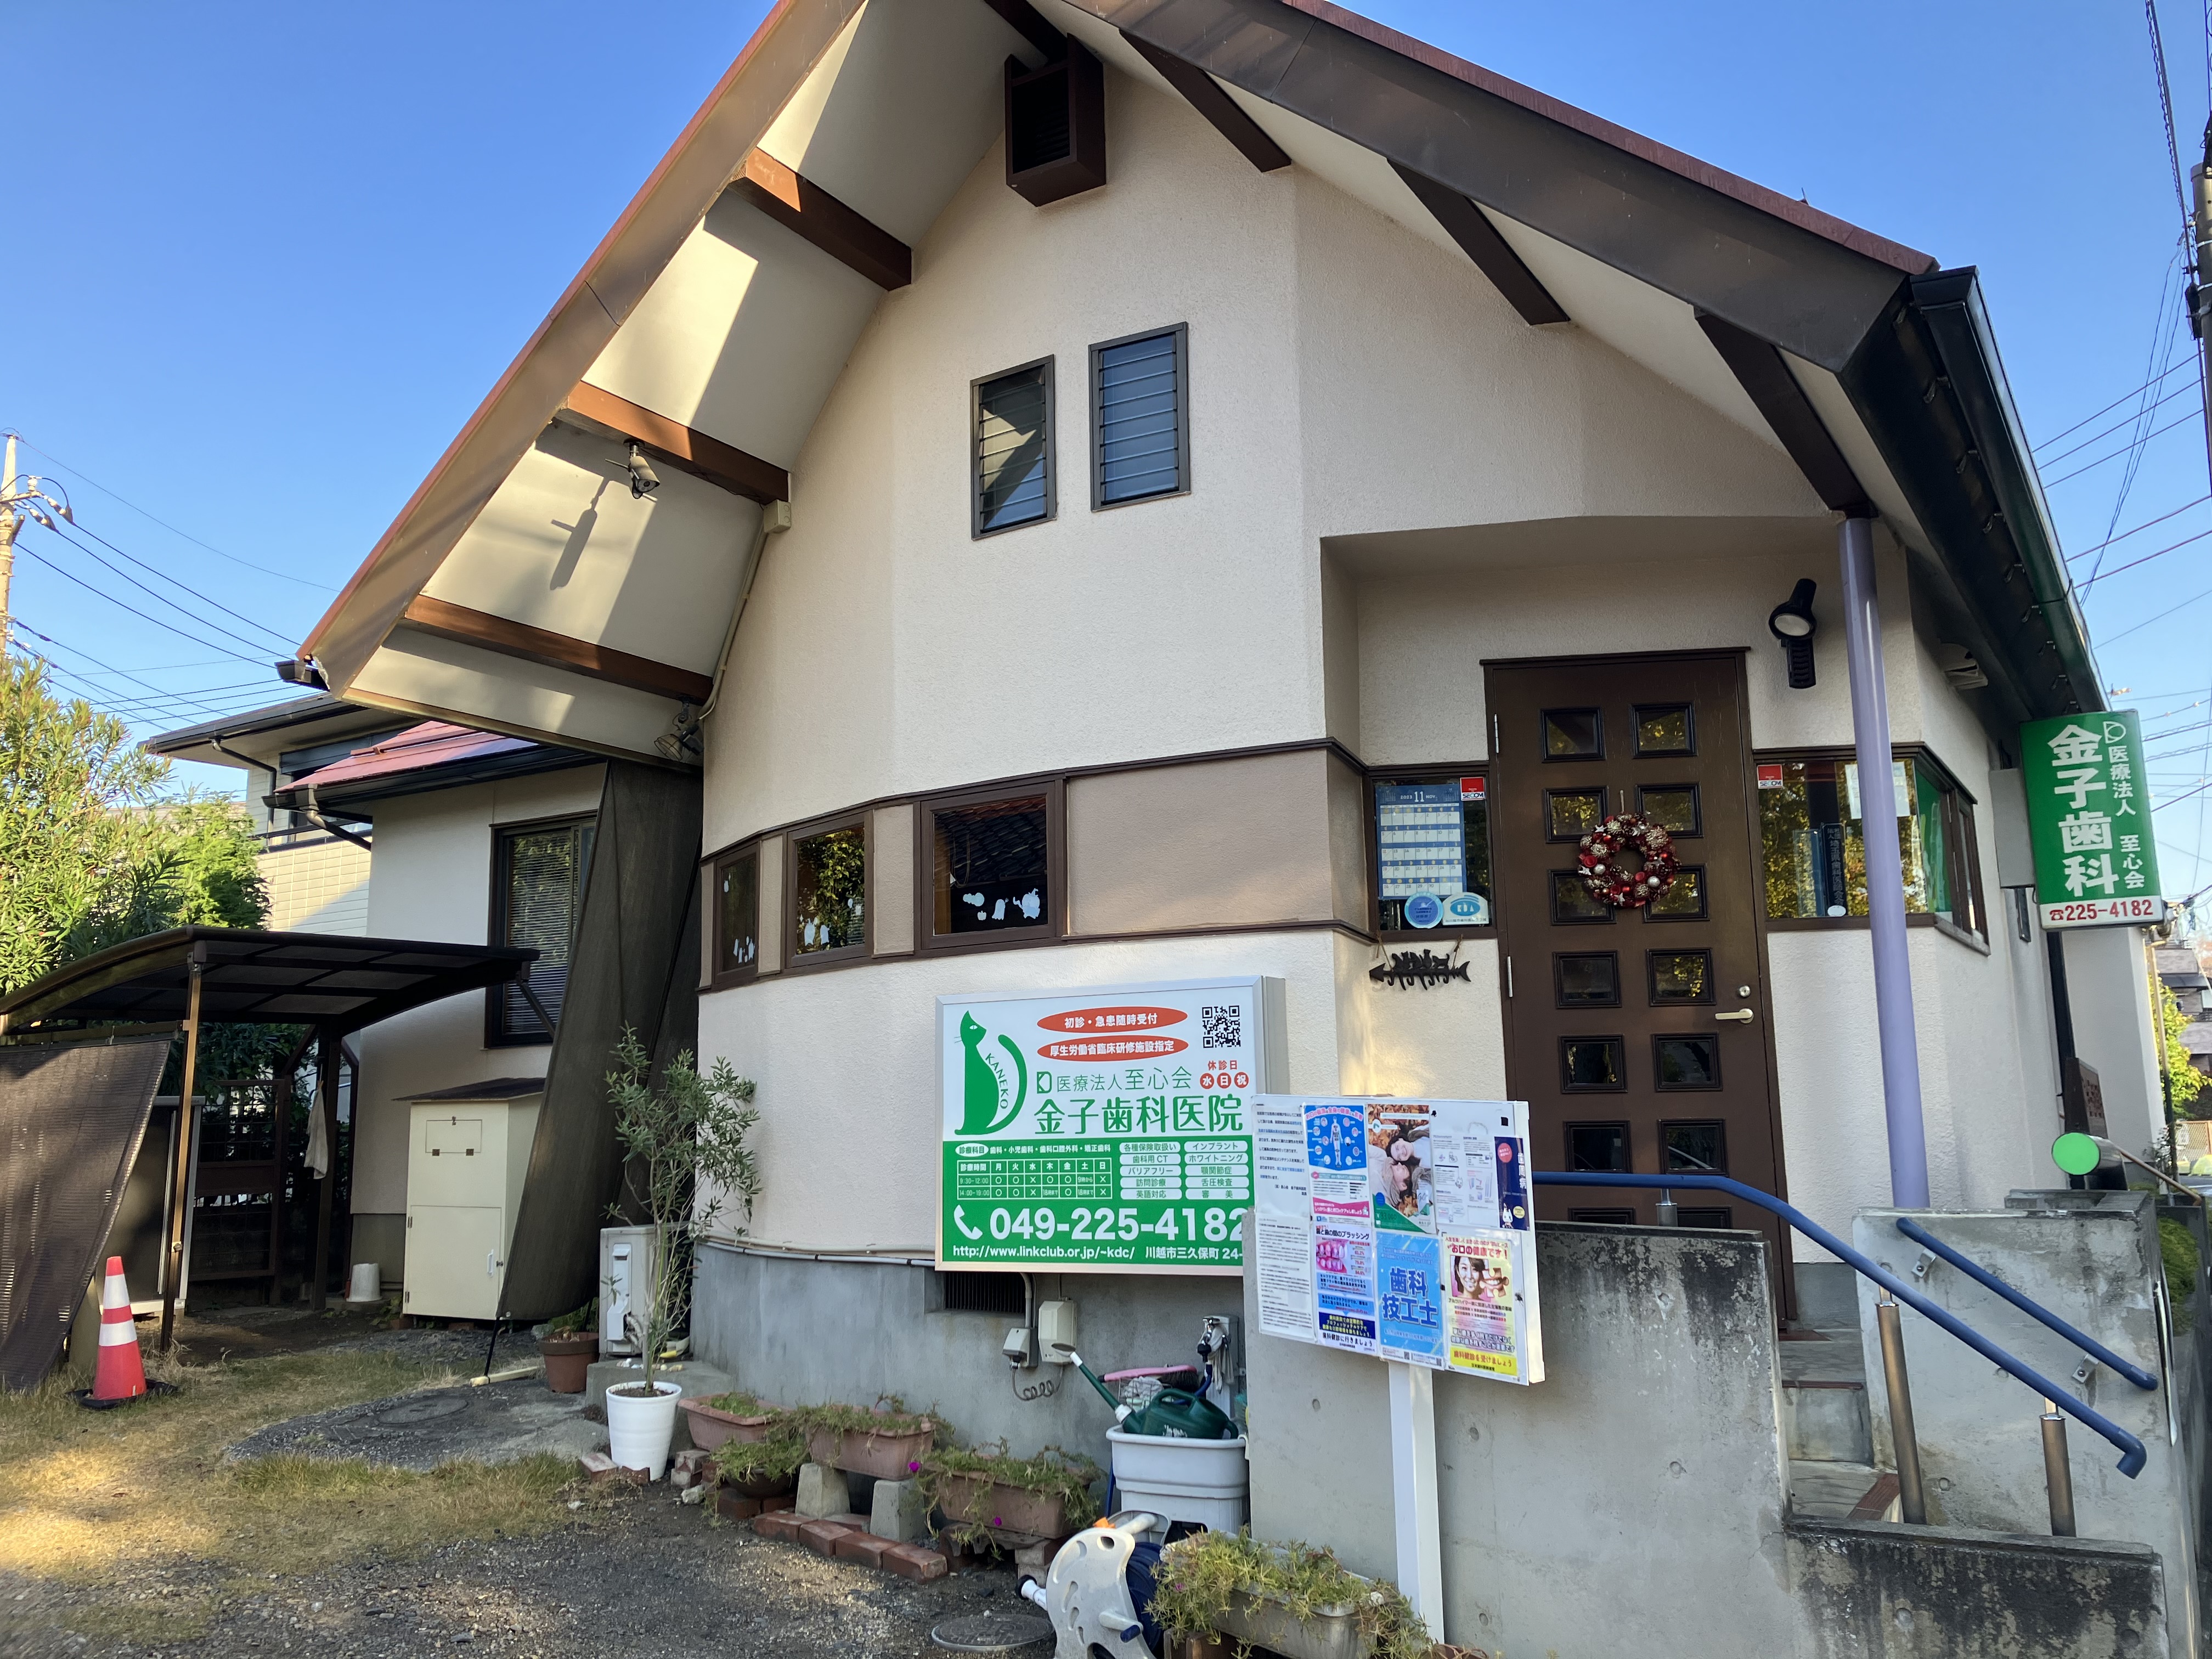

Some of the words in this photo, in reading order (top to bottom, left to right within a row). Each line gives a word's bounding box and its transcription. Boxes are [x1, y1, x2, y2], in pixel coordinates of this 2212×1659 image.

[2108, 745, 2136, 816] 医療法人
[1414, 791, 1424, 802] 11
[2047, 724, 2120, 897] 金子歯科
[2119, 834, 2145, 889] 至心会
[1457, 904, 1474, 912] KDA
[2065, 899, 2153, 921] 225-4182
[1064, 1013, 1158, 1029] 初診・急患随時受付
[1050, 1041, 1174, 1057] 厚生労働省臨床研修施設指定
[1208, 1060, 1238, 1070] 休診日
[985, 1053, 1008, 1109] KANEKO
[1057, 1066, 1192, 1092] 医療法人至心会
[1203, 1076, 1212, 1086] 水
[1237, 1075, 1247, 1085] 祝
[1034, 1093, 1243, 1135] 金子歯科医院
[1124, 1143, 1176, 1152] 各種保険取扱い
[1193, 1142, 1238, 1150] インプラント
[1133, 1155, 1155, 1164] 歯科用
[1157, 1155, 1168, 1163] CT
[1189, 1154, 1243, 1163] ホワイトニング
[961, 1163, 986, 1171] 診療時間
[1128, 1167, 1173, 1175] バリアフリー
[1201, 1166, 1232, 1175] 顎関節症
[1517, 1152, 1527, 1189] 歯周病
[1136, 1178, 1166, 1187] 訪問診療
[1201, 1178, 1233, 1187] 舌圧検査
[1136, 1190, 1167, 1198] 英語対応
[990, 1207, 1243, 1242] 049-225-4182
[953, 1245, 1135, 1260] http://www.linkclub.or.jp/~kdc/
[1146, 1246, 1219, 1260] 川越市三久保町
[1390, 1267, 1427, 1297] 歯科
[1383, 1293, 1438, 1327] 技工士
[1454, 1351, 1512, 1367] 歯科健診を受けましょう
